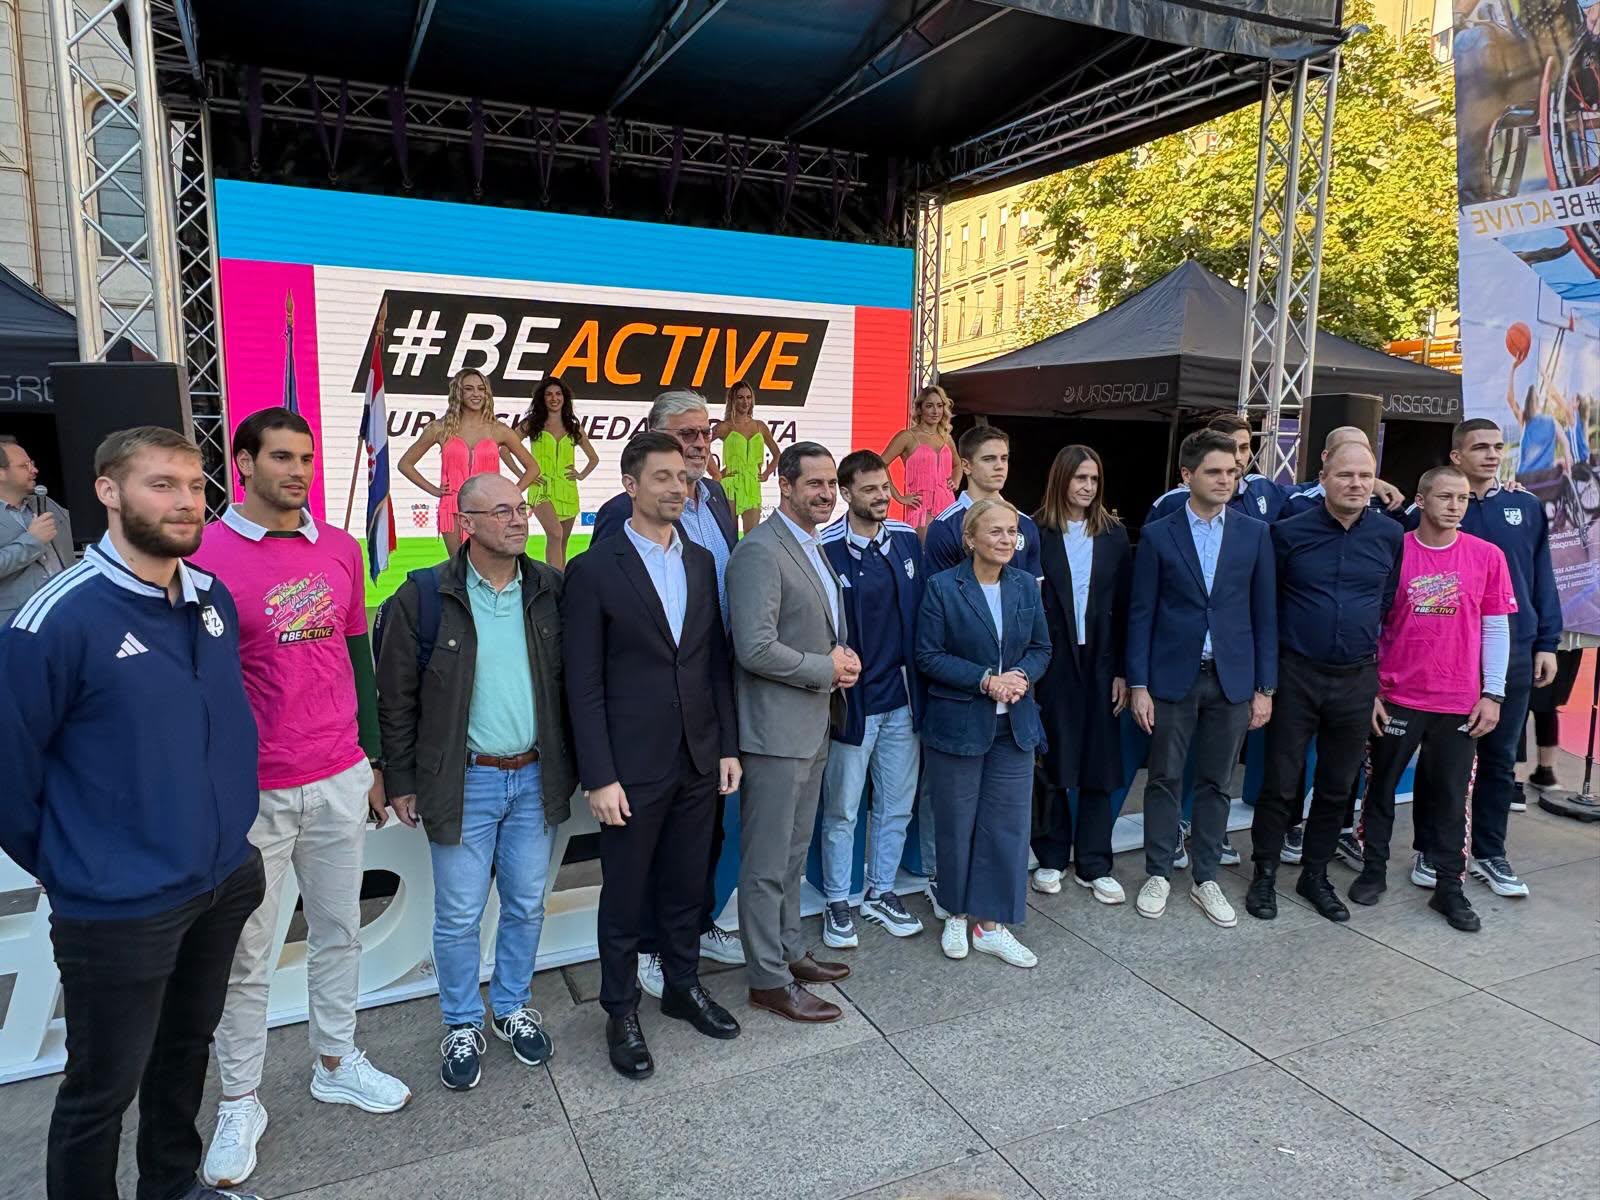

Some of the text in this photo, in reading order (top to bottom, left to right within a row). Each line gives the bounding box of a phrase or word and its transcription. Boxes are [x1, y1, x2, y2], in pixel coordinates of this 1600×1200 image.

[387, 309, 809, 391] #BEACTIVE
[1414, 606, 1456, 615] #BEACTIVE
[281, 627, 333, 642] #BEACTIVE
